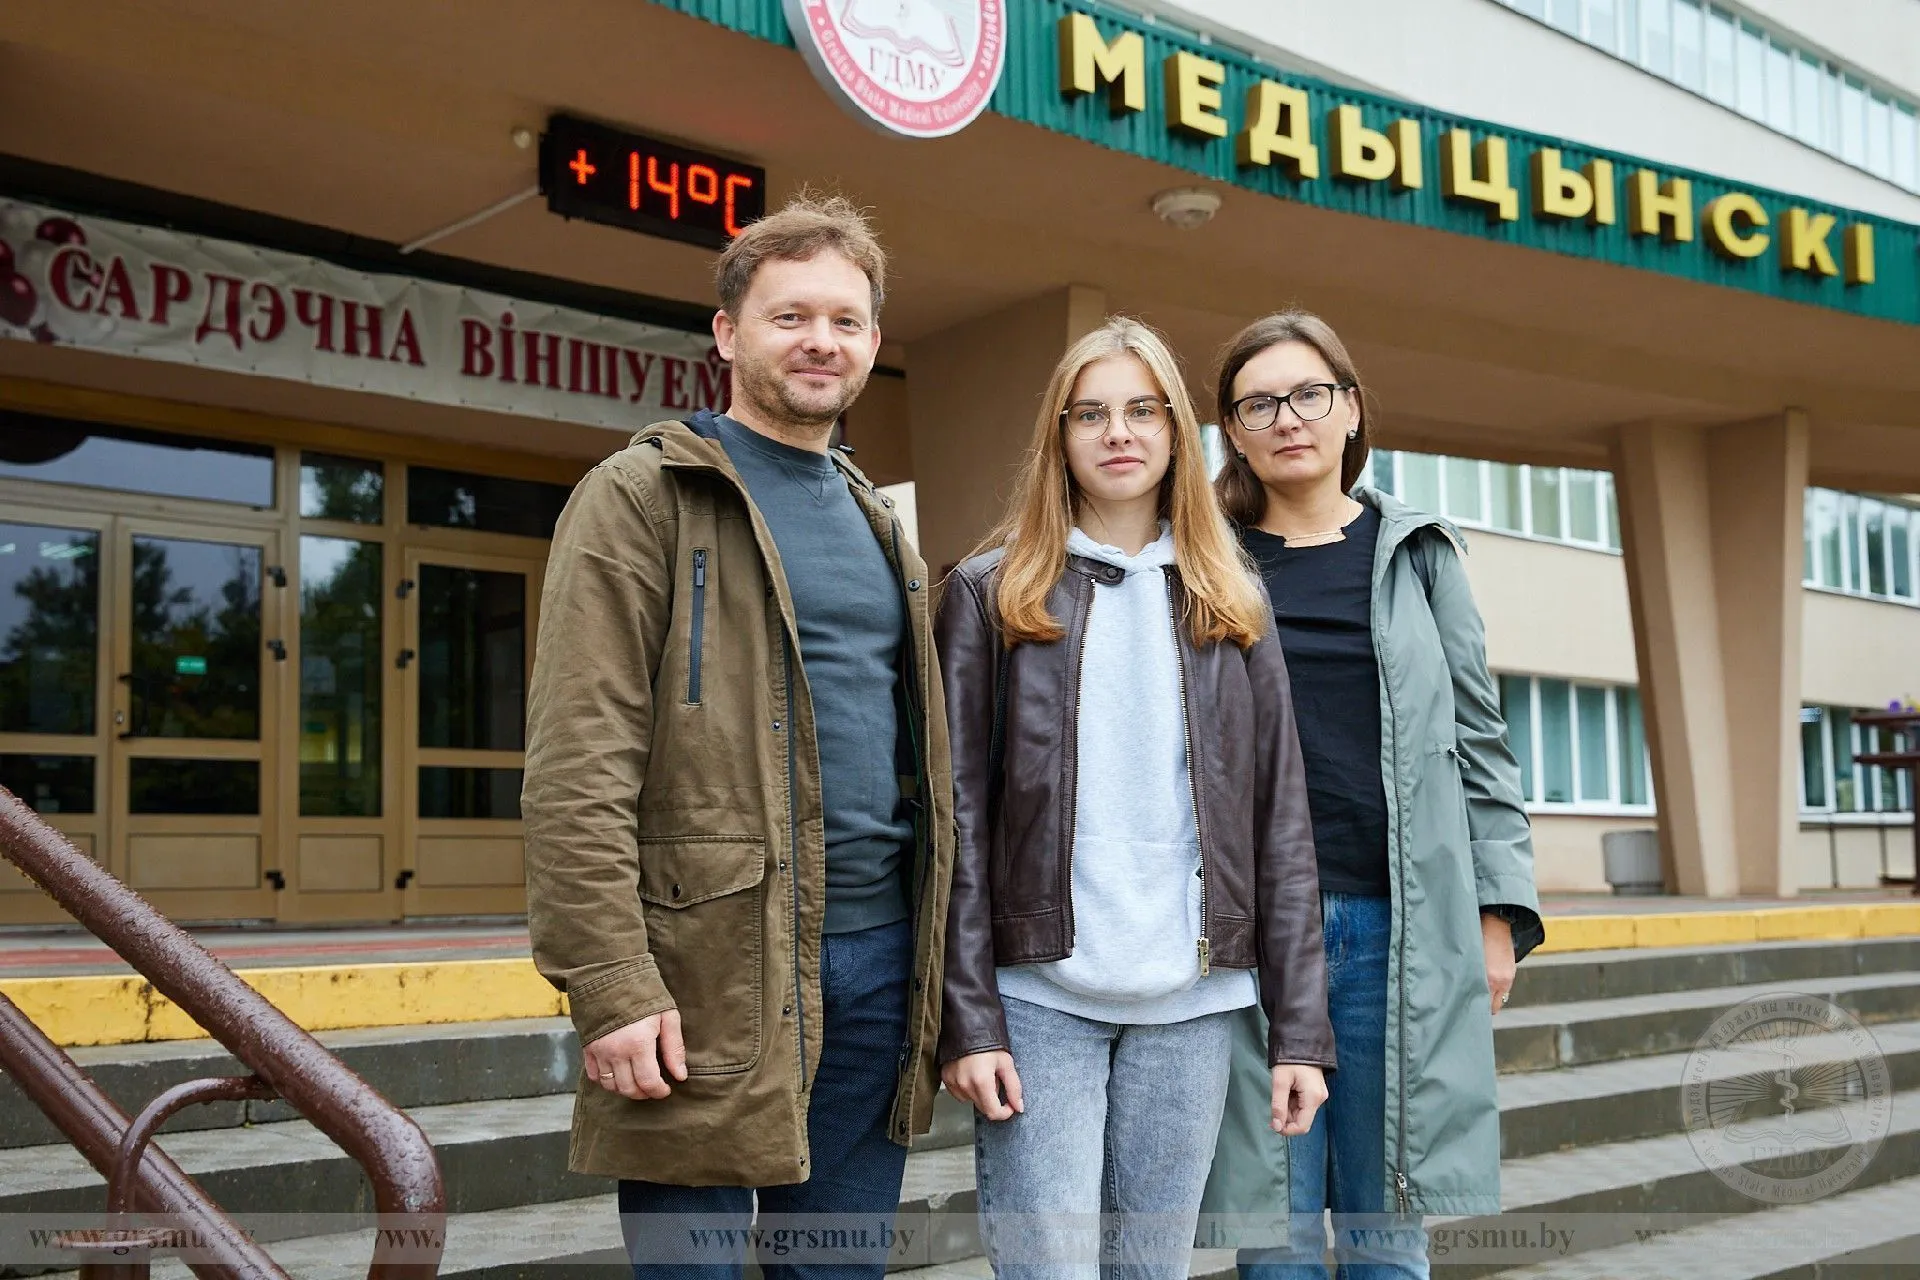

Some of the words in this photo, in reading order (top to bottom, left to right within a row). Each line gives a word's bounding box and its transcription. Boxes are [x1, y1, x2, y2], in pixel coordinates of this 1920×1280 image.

[868, 45, 945, 93] ГДМУ
[1059, 12, 1875, 284] МЕДЫЦЫНСКІ
[49, 245, 426, 367] САРДЭЧНА
